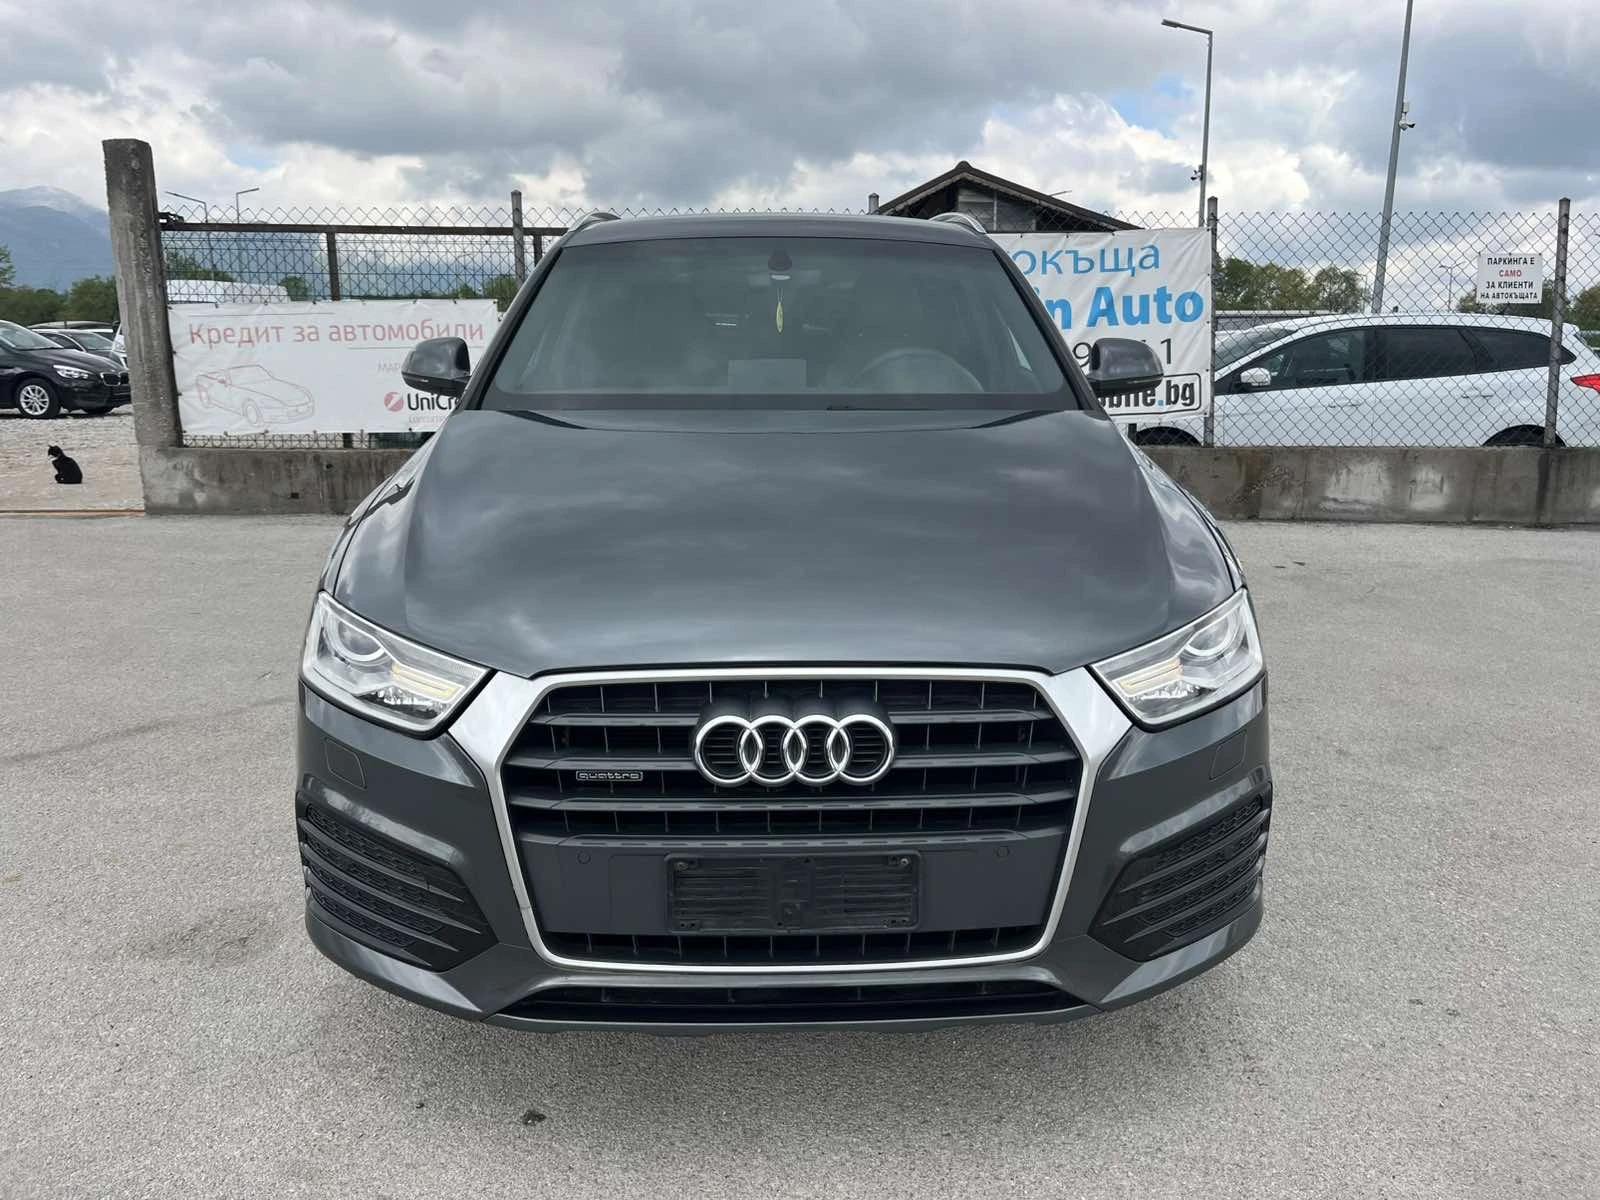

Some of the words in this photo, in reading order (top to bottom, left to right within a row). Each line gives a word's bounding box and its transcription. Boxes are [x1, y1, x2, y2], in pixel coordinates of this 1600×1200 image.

[1487, 257, 1528, 265] ПАРКИНГА
[1499, 269, 1522, 277] САМО
[1486, 281, 1496, 289] ЗА
[1498, 281, 1533, 289] КЛИЕНТИ
[1480, 292, 1490, 300] НА
[1492, 292, 1538, 300] АВТОКЪЩАТА
[1087, 286, 1204, 328] Auto
[292, 325, 320, 342] за
[328, 318, 483, 342] автомобили
[579, 771, 640, 780] quattro
